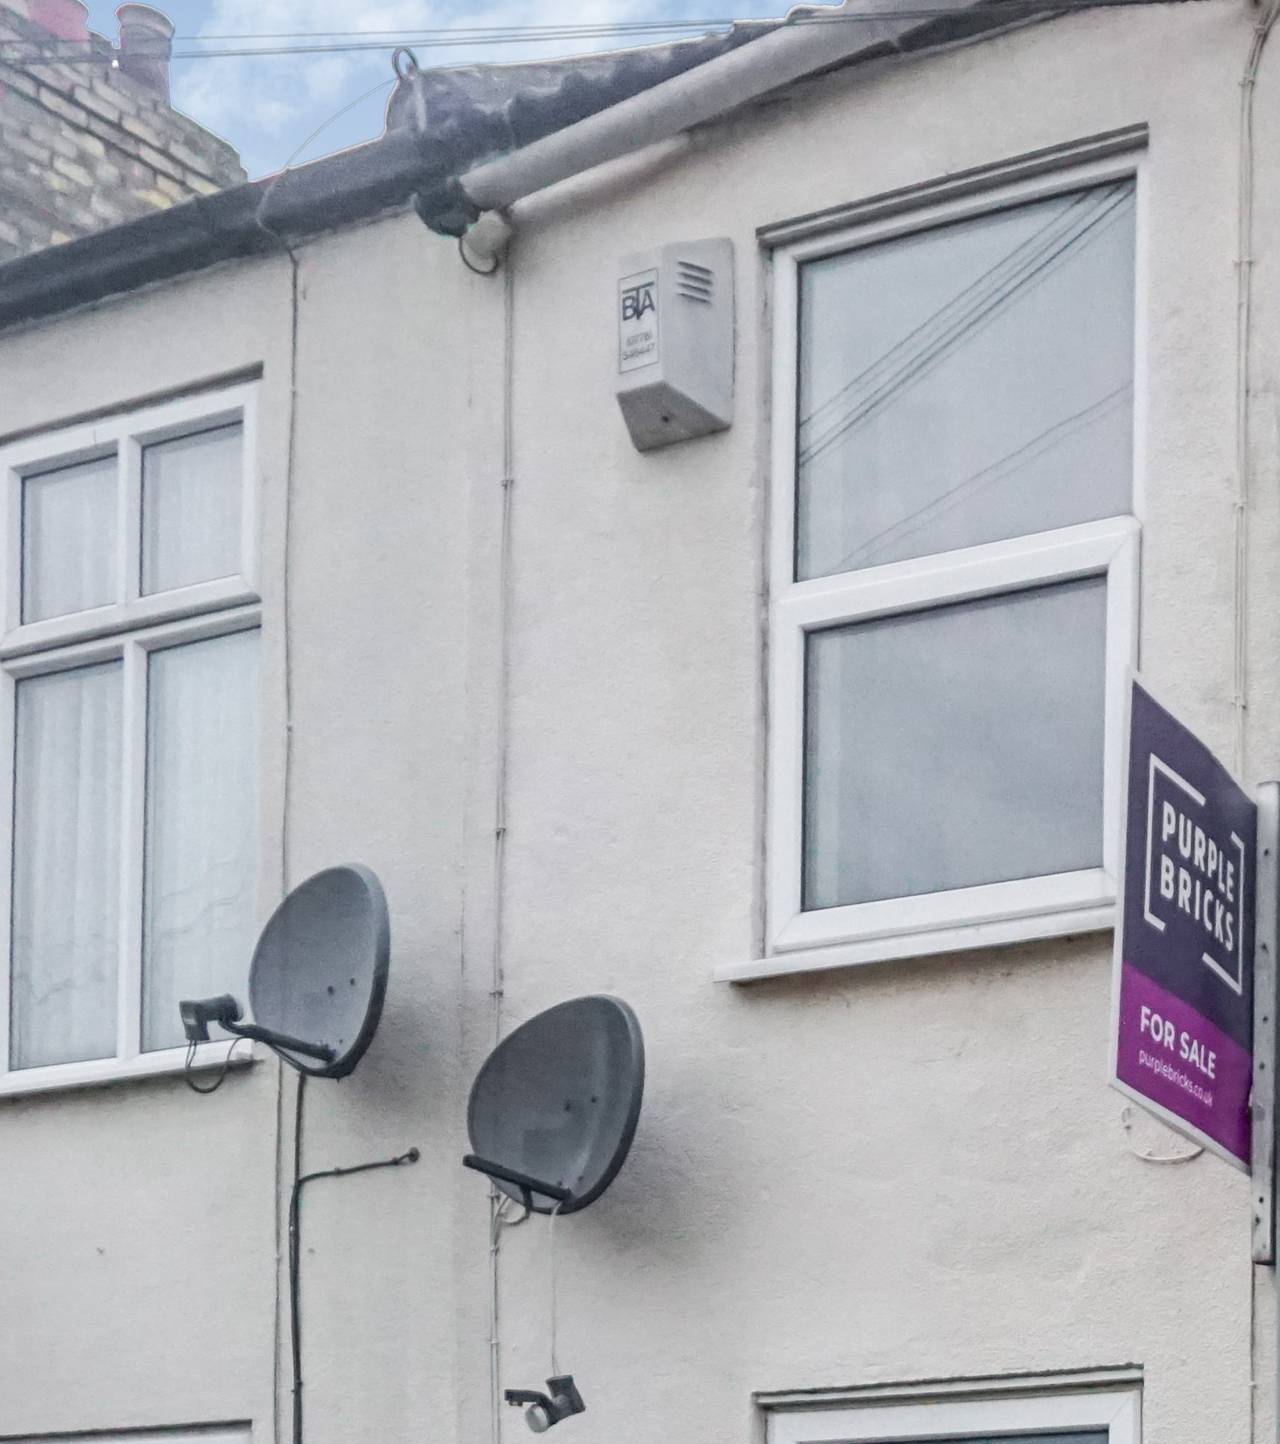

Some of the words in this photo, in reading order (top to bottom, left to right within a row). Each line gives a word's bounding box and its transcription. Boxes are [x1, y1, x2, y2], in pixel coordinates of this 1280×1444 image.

[622, 281, 656, 321] BTA
[1162, 800, 1234, 902] PURPLE
[1160, 853, 1234, 952] BRICKS
[1139, 1049, 1213, 1107] purplebricks.co.uk
[1140, 1005, 1175, 1051] FOR
[1180, 1031, 1217, 1079] SALE
